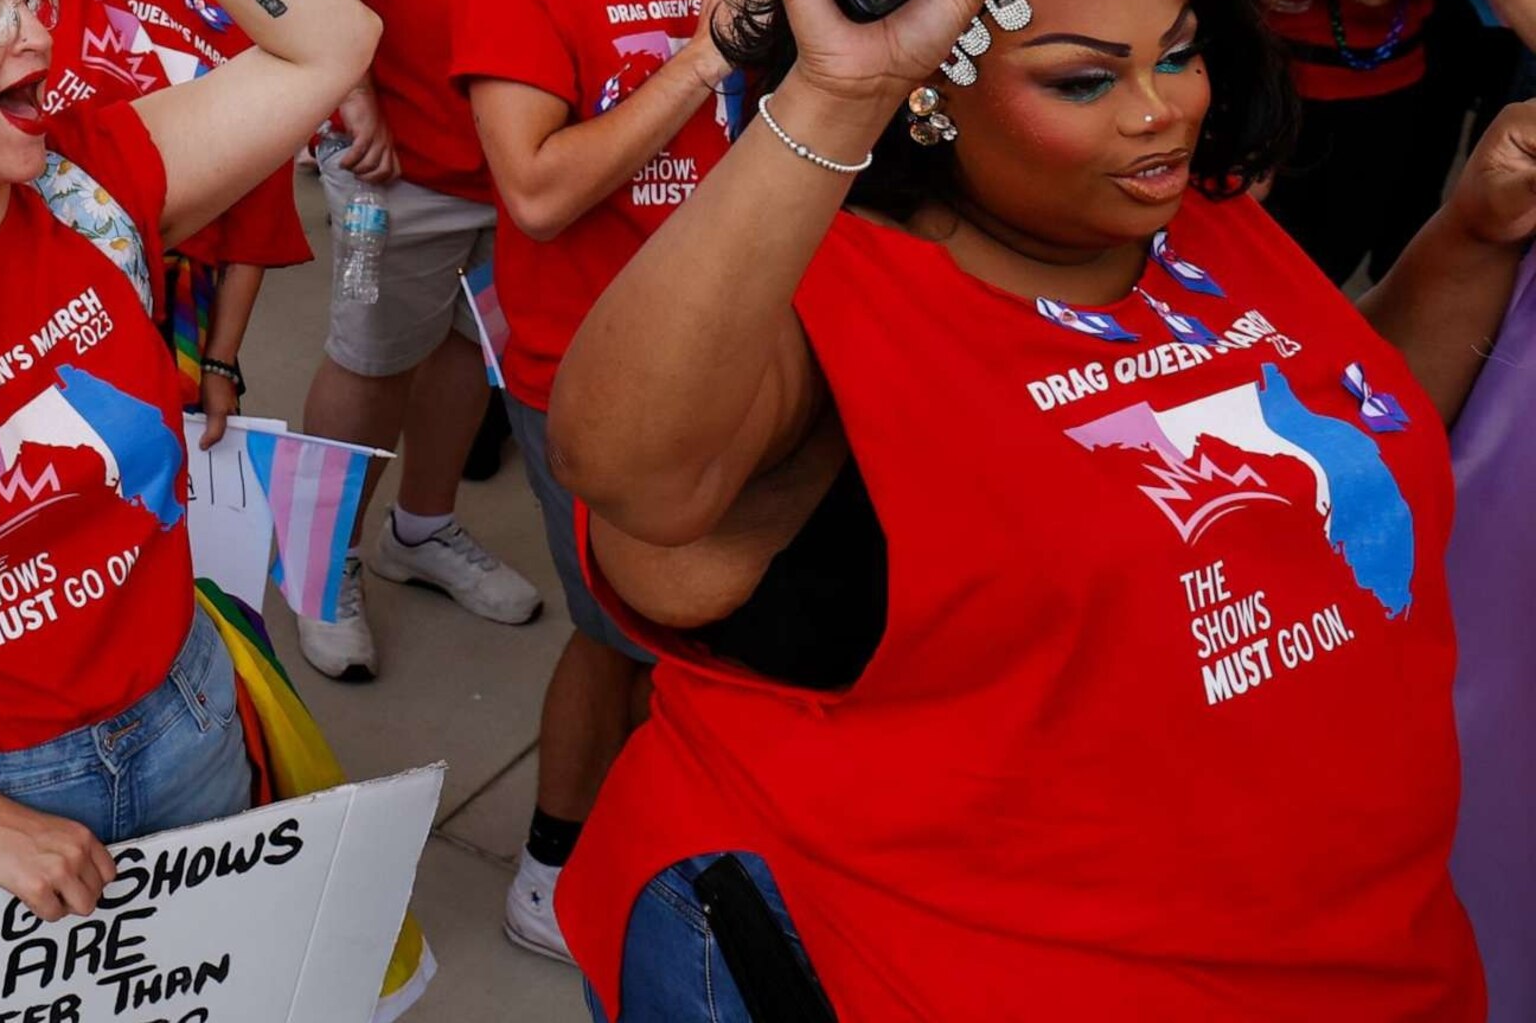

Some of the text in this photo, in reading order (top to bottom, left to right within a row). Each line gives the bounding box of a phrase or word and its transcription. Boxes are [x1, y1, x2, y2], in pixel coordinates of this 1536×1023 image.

[606, 3, 648, 24] DRAG
[632, 183, 697, 206] MUST
[30, 286, 103, 358] MARCH
[69, 310, 114, 355] 2023
[1026, 362, 1110, 412] DRAG
[63, 568, 105, 609] GO
[1180, 559, 1232, 612] THE
[1190, 590, 1272, 659] SHOWS
[1200, 603, 1356, 706] MUST GO ON.
[99, 817, 304, 911] SHOWS
[1, 906, 159, 1000] ARE
[96, 952, 232, 1015] THAN
